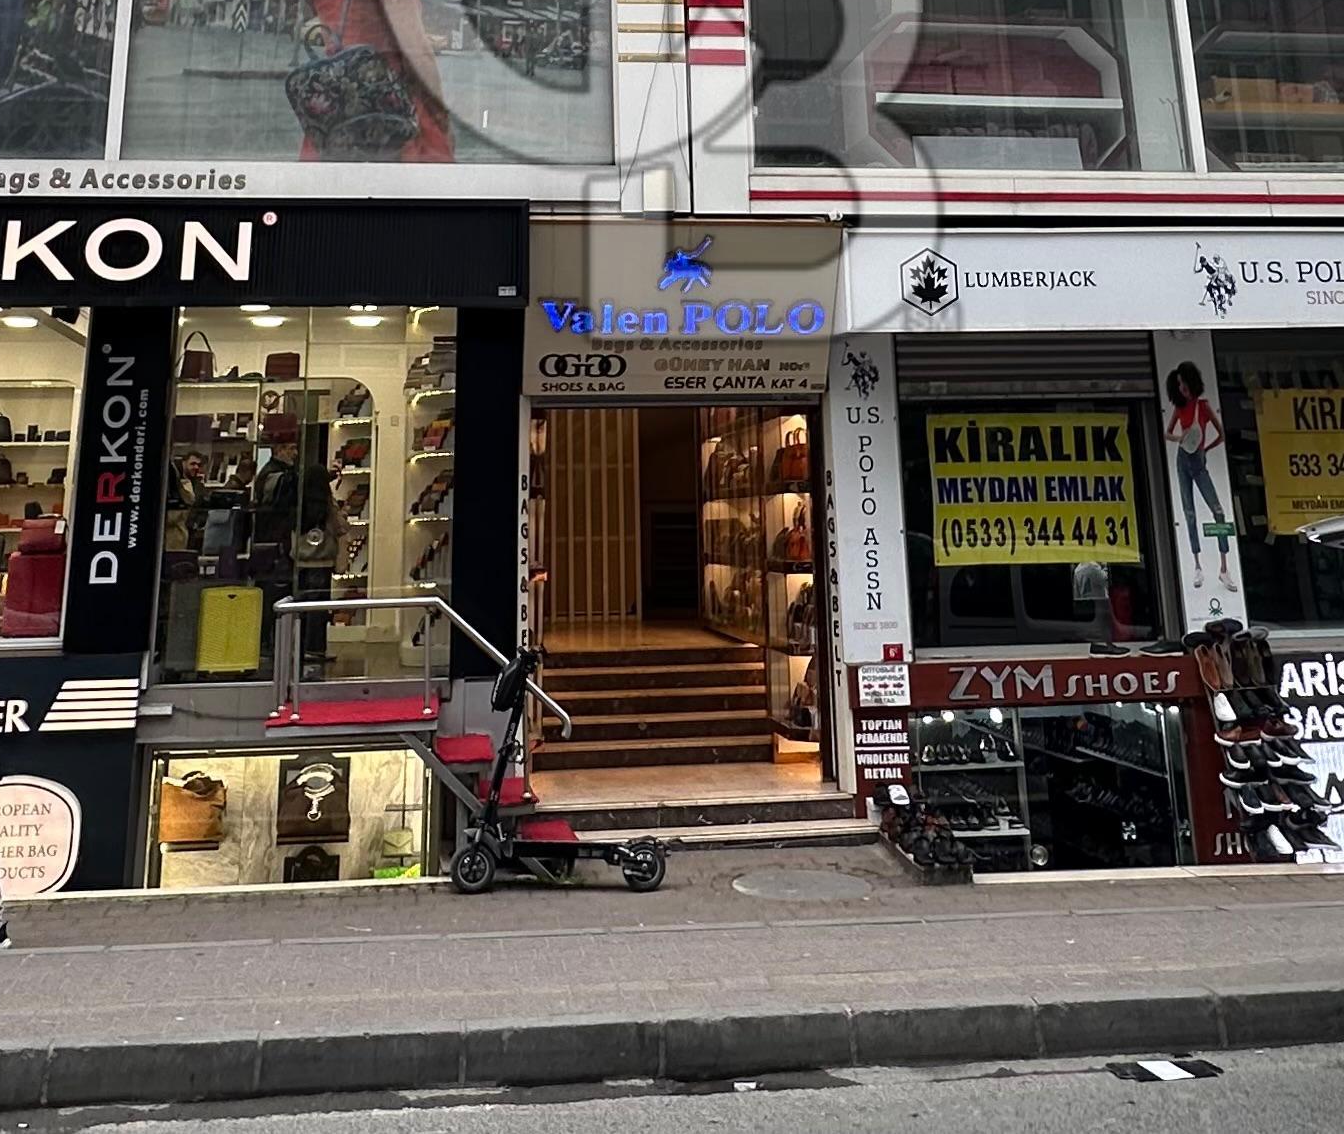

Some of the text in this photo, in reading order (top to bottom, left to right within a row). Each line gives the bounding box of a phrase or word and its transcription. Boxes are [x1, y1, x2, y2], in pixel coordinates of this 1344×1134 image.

[50, 168, 71, 188] &
[80, 168, 247, 190] Accessories
[965, 271, 1096, 290] LUMBERJACK
[1239, 262, 1288, 283] U.S.
[540, 299, 826, 336] Valen POLO
[592, 337, 763, 353] Bags & Accessories
[728, 359, 770, 371] HAN
[542, 382, 583, 392] SHOES
[664, 377, 706, 389] ESER
[713, 377, 765, 391] ÇANTA
[771, 379, 794, 389] KAT
[799, 379, 808, 389] 4
[846, 407, 884, 424] U.S.
[934, 420, 1123, 463] KİRALIK
[89, 357, 135, 584] DERKON
[1289, 454, 1321, 476] 533
[859, 435, 876, 515] POLO
[937, 476, 1125, 504] MEYDAN EMLAK
[1292, 499, 1328, 509] MEYDAN
[942, 517, 1130, 556] (0533) 344 44 31
[864, 528, 882, 610] ASSN
[949, 665, 1180, 700] ZYM SHOES
[861, 720, 902, 732] TOPTAN
[856, 733, 908, 745] PERAKENDE
[857, 753, 909, 765] WHOLESALE
[864, 767, 903, 780] RETAIL
[28, 845, 58, 858] BAG
